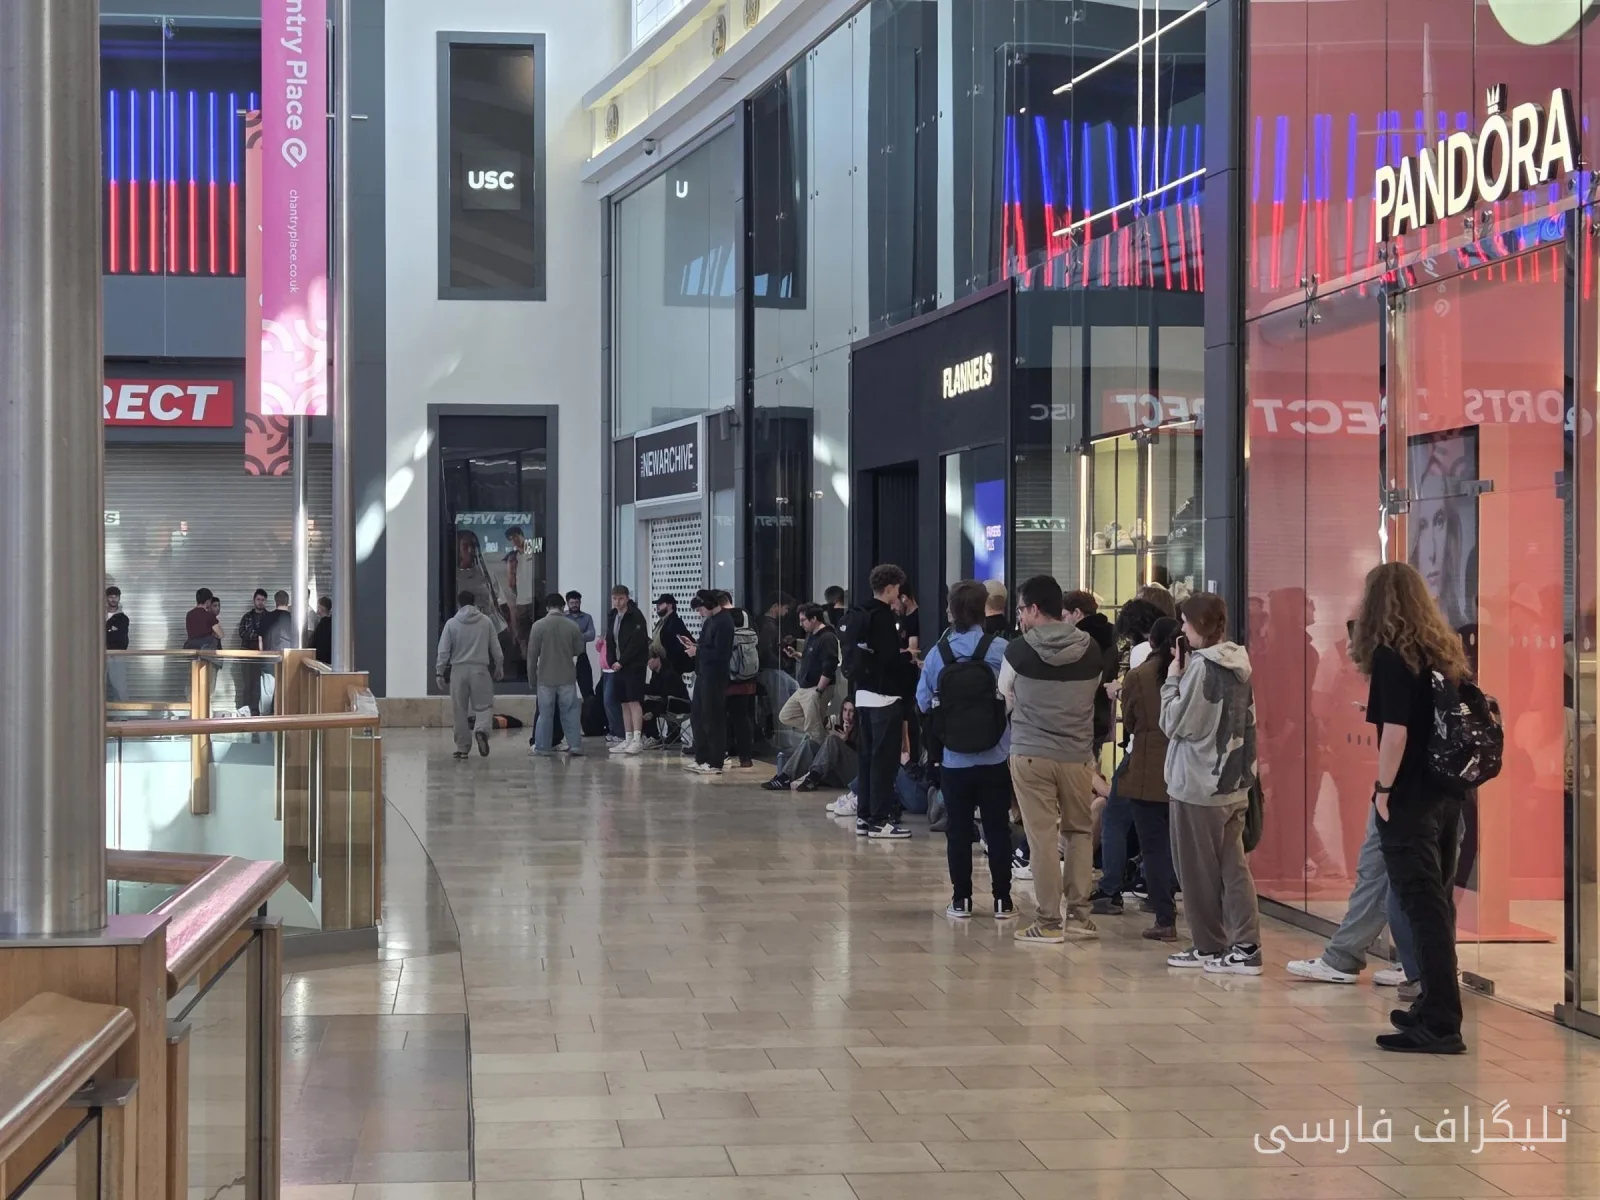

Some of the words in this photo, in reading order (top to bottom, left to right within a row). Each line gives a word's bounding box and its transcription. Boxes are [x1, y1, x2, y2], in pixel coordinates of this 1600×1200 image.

[285, 60, 308, 131] Place
[468, 170, 515, 190] USC
[1375, 86, 1574, 244] PANDORA
[288, 189, 299, 294] chantryplace.co.uk
[942, 352, 993, 399] FLANNELS
[454, 513, 497, 525] FSTVL
[503, 513, 532, 525] SZN
